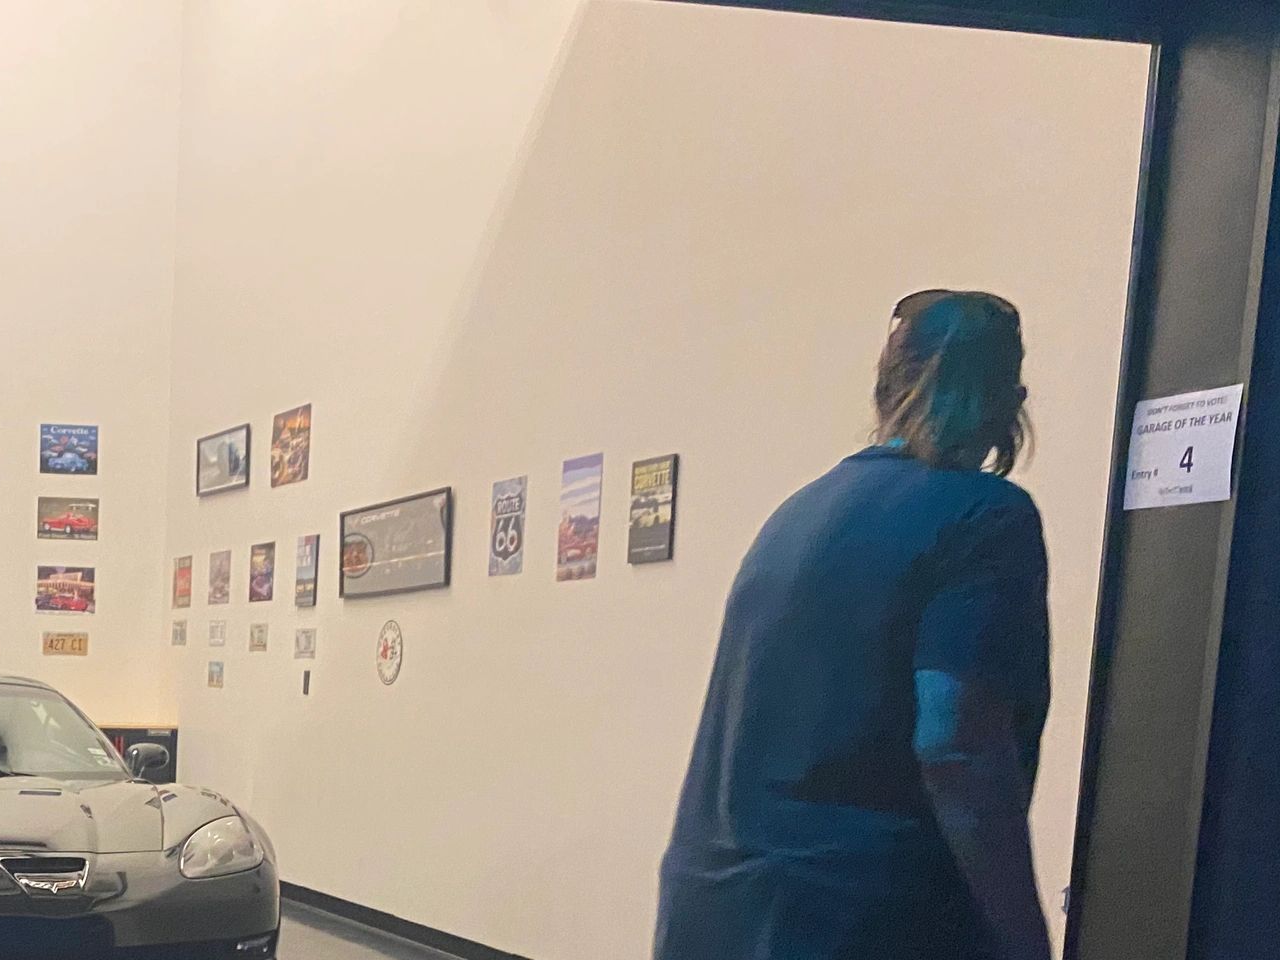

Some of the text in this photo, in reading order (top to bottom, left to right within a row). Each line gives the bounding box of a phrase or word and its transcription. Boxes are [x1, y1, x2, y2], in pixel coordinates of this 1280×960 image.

[1136, 411, 1233, 436] GARAGE OF THE YEAR
[1179, 446, 1194, 474] 4
[1131, 470, 1153, 480] Entry
[496, 498, 521, 514] ROUTE
[495, 518, 518, 552] 66
[48, 638, 65, 651] 427
